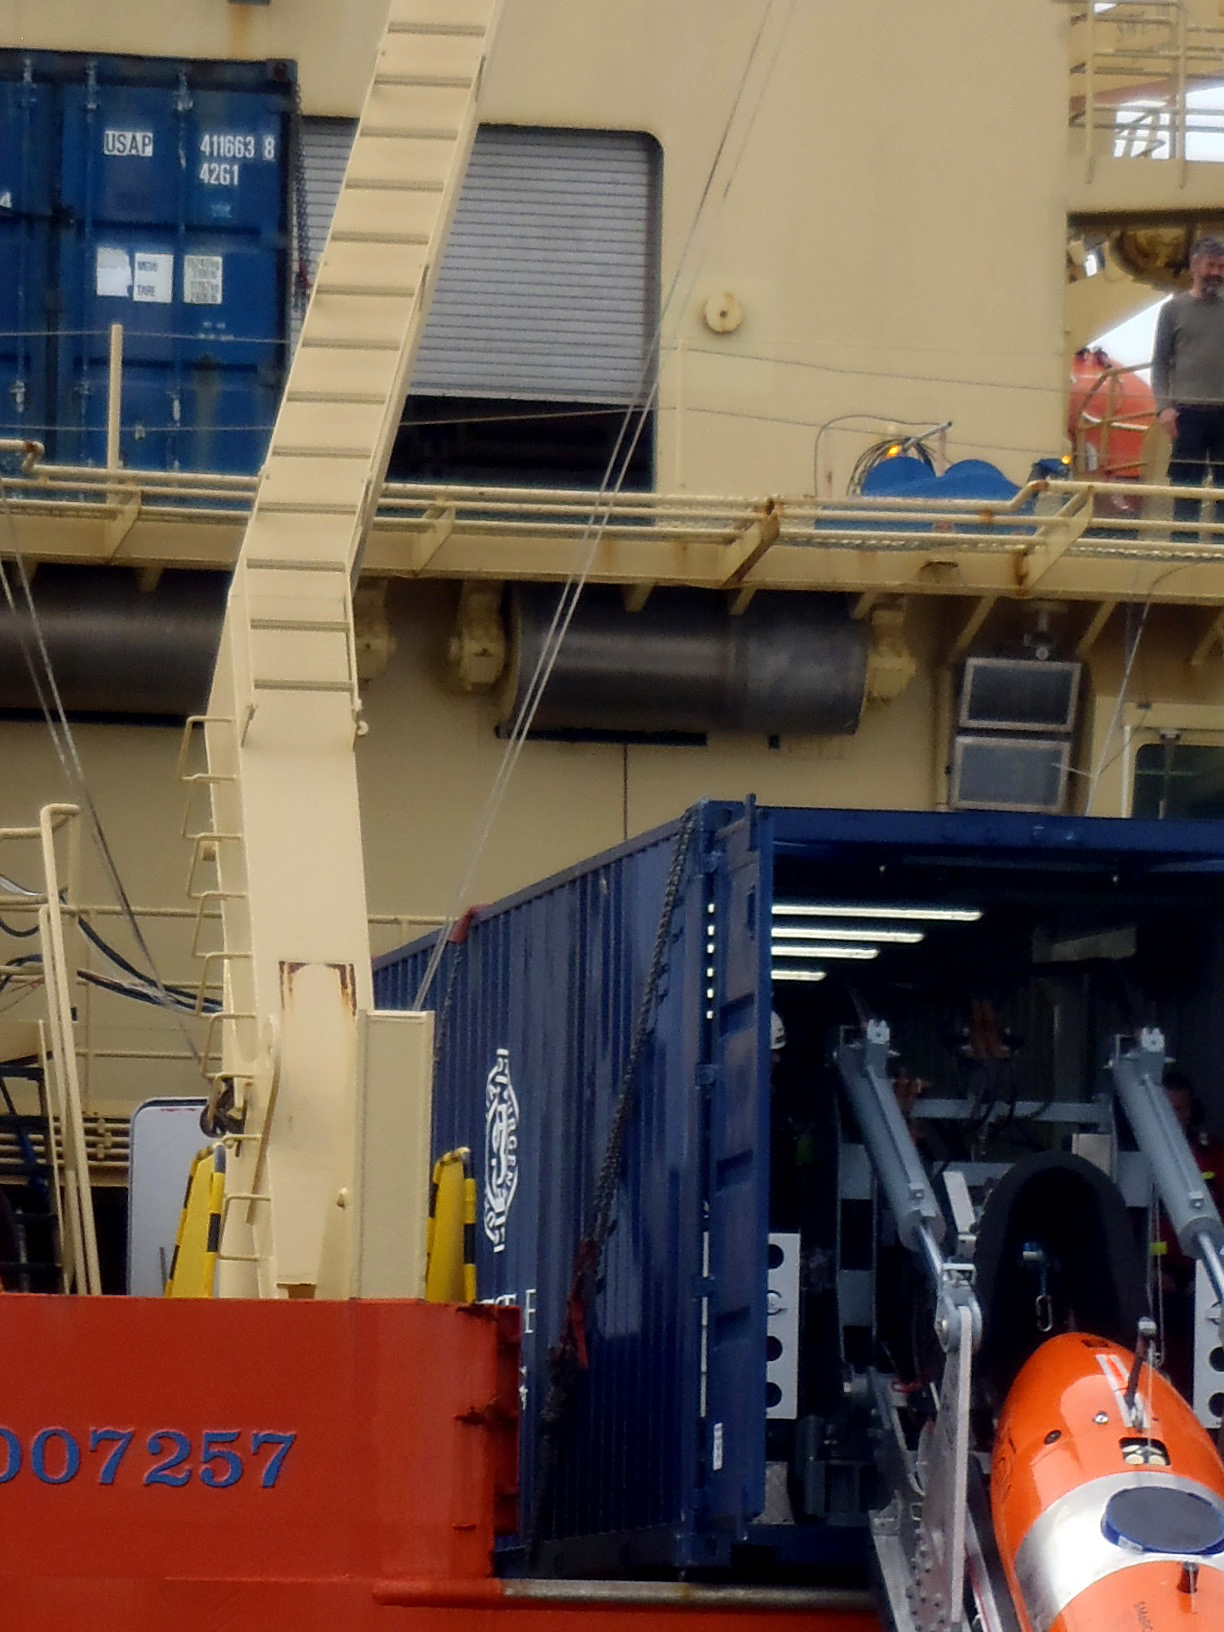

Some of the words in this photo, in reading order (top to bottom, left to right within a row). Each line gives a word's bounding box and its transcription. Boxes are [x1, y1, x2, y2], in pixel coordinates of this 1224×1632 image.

[104, 133, 152, 157] USAP
[201, 134, 255, 159] 411663
[265, 137, 275, 159] 8
